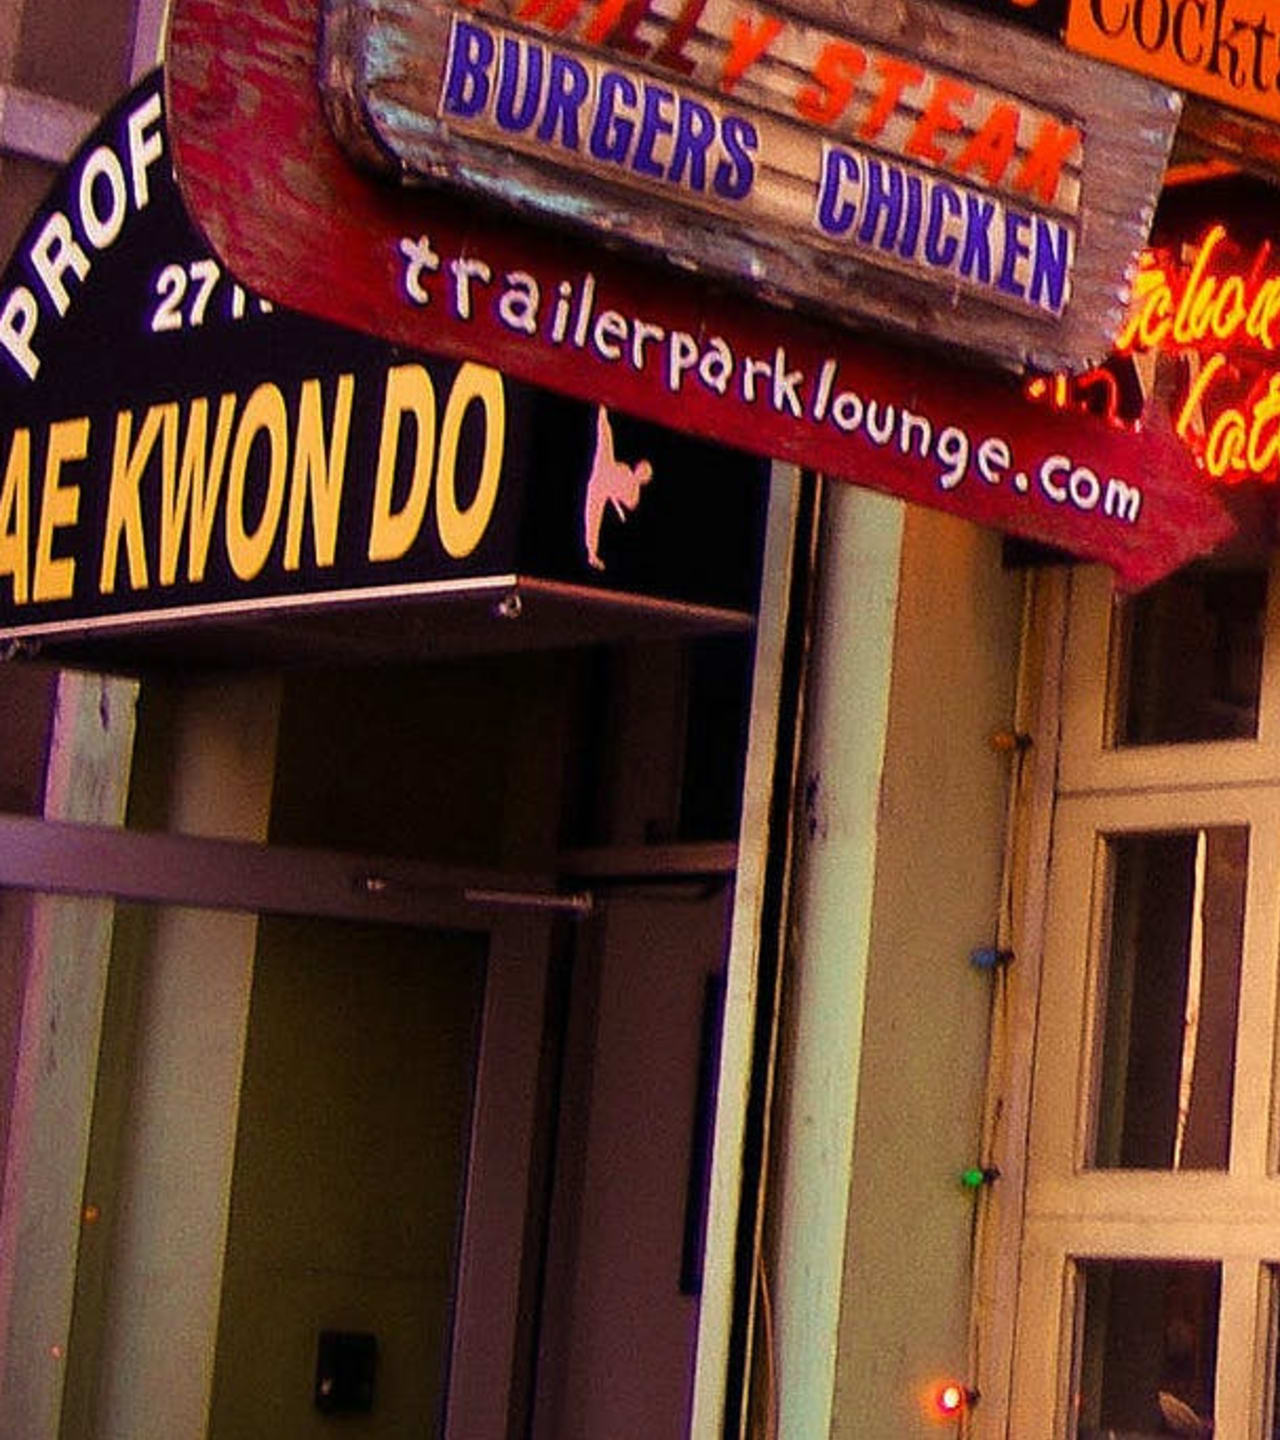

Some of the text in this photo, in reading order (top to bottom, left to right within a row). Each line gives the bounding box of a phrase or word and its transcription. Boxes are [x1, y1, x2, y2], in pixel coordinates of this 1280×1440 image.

[445, 18, 1072, 313] BURGERS CHICKEN
[797, 41, 1081, 205] STEAK
[99, 392, 355, 596] KWON
[367, 361, 506, 560] DO
[400, 234, 1142, 522] trailerparklounge.com
